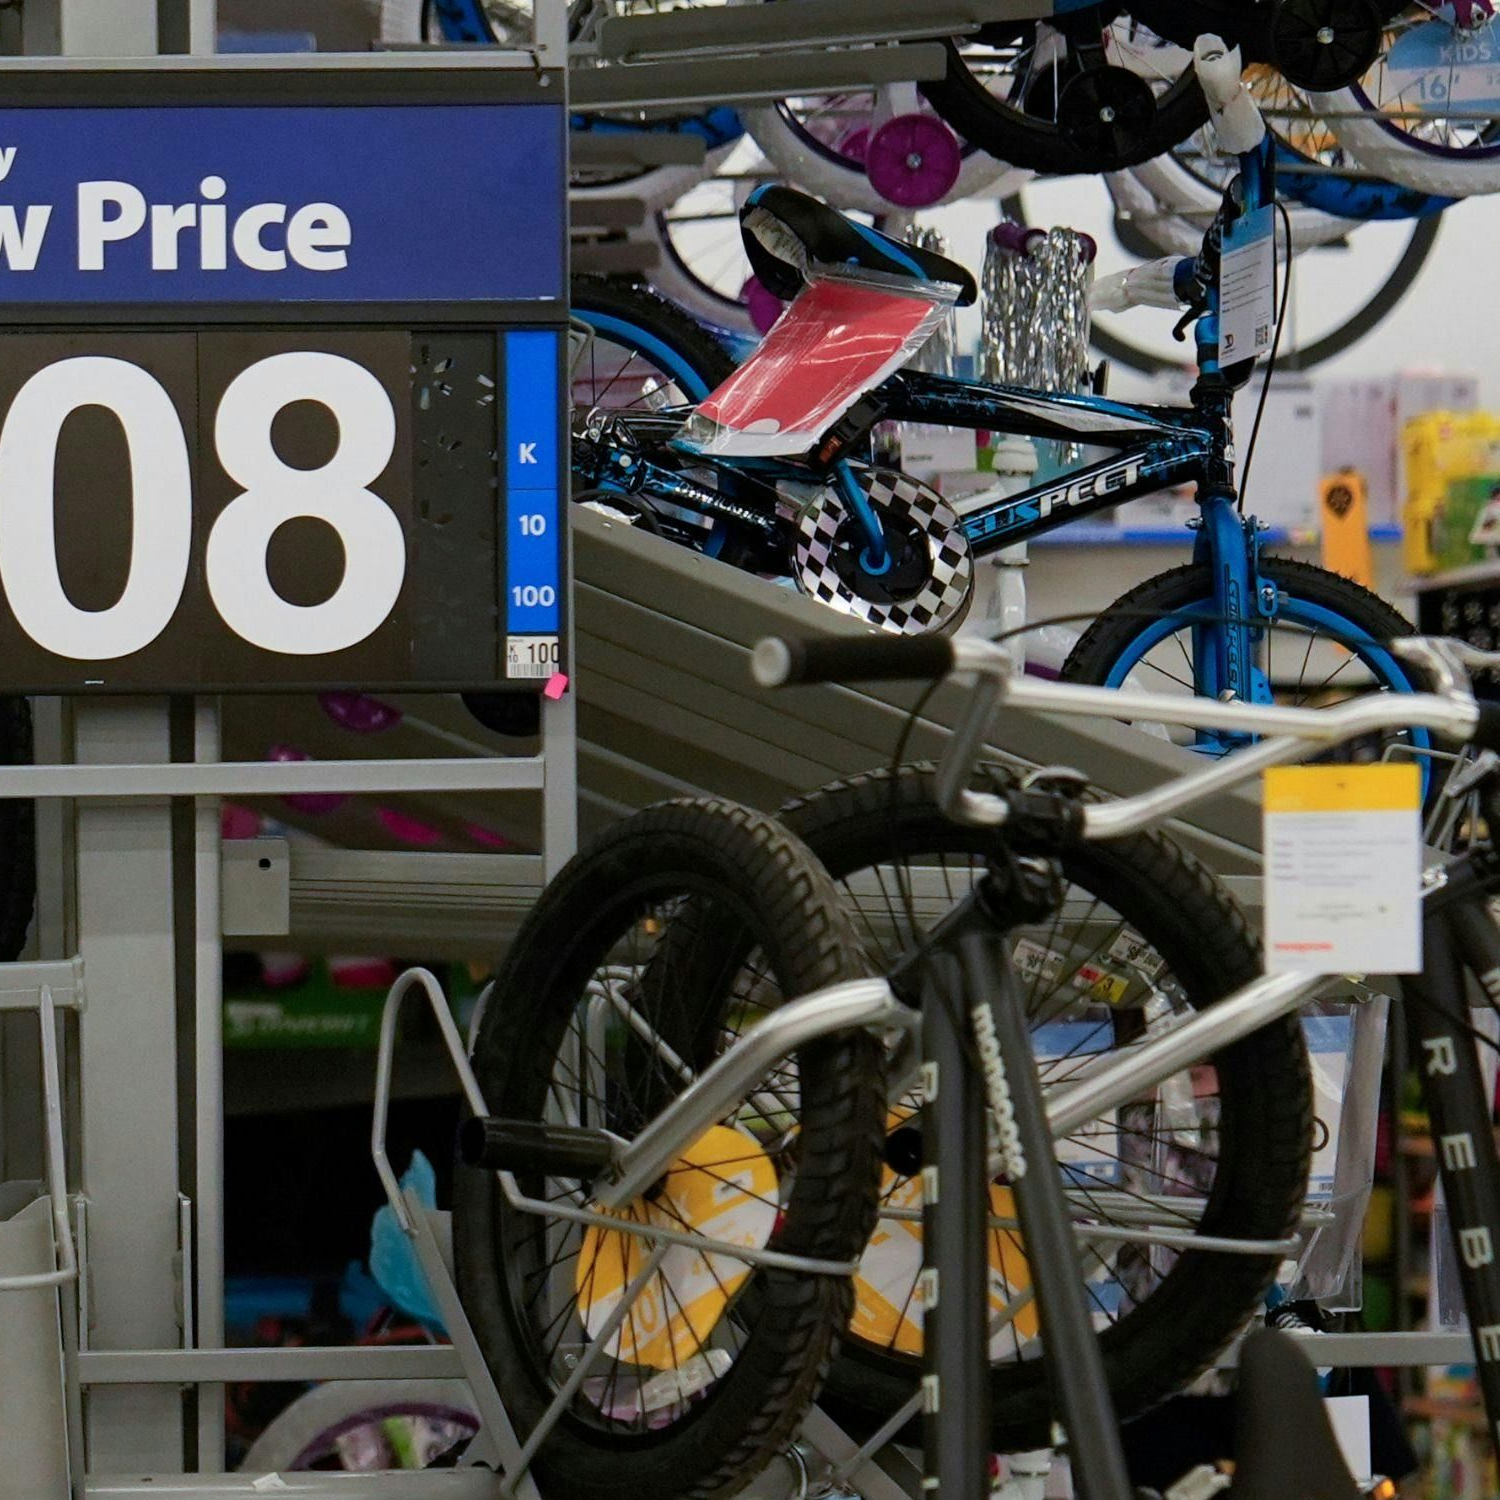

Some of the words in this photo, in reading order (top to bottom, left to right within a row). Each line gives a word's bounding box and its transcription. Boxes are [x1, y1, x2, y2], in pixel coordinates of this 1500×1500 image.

[77, 175, 353, 273] Price
[518, 442, 538, 464] K
[518, 514, 546, 536] 10
[511, 585, 556, 607] 100
[527, 642, 560, 664] 100
